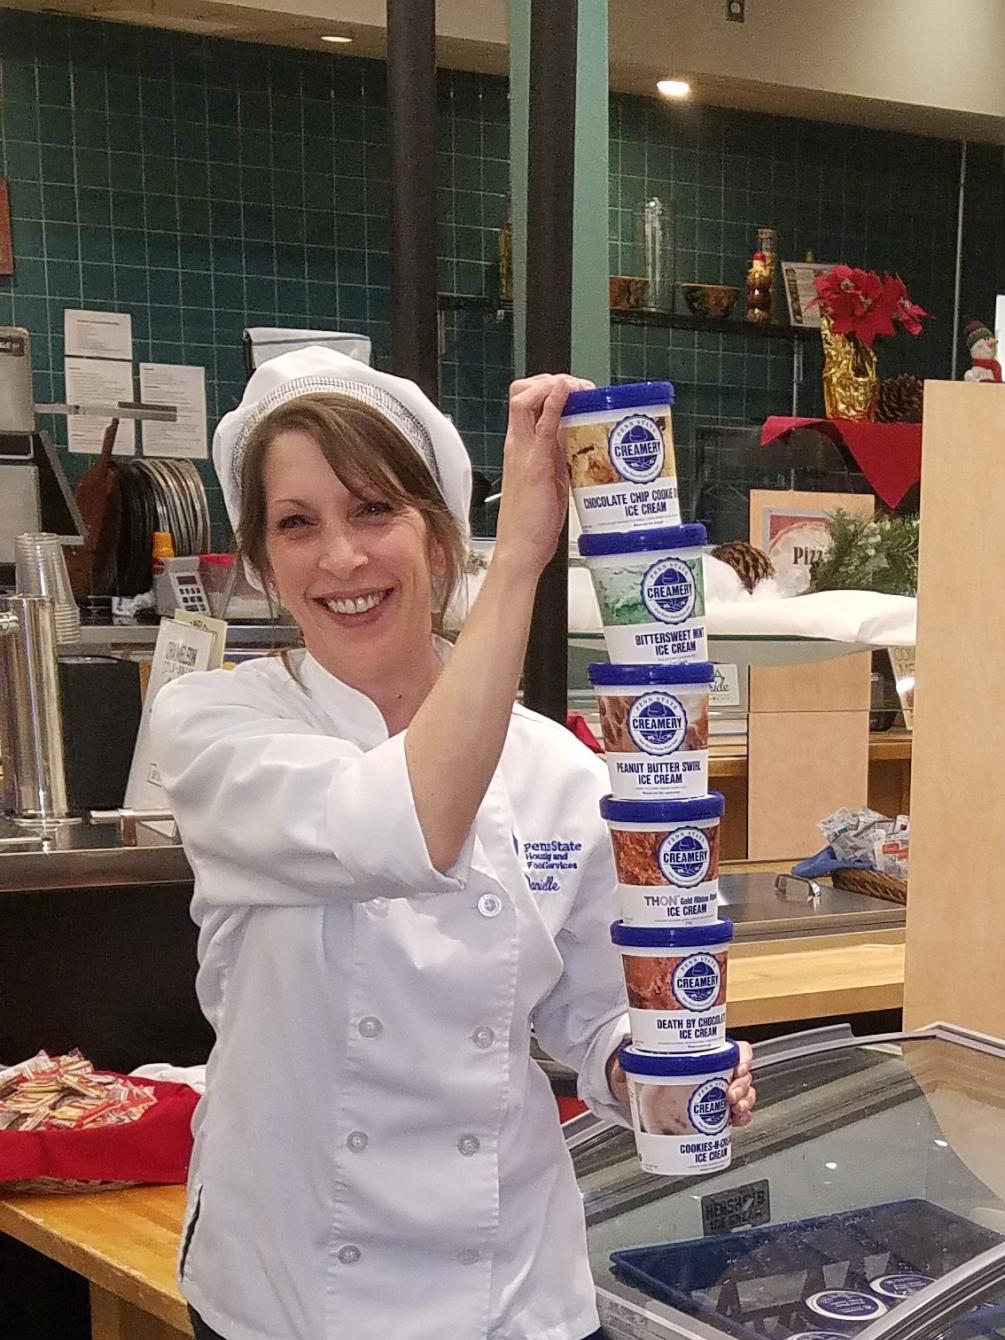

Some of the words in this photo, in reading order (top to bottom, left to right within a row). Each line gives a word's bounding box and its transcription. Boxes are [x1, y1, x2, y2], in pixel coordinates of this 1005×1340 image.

[583, 493, 627, 509] CHOCOLATE
[630, 490, 650, 504] CHIP
[624, 505, 639, 517] ICE
[641, 502, 667, 514] CREAM
[793, 546, 824, 565] Pizz
[635, 629, 691, 646] BITTERSWEET
[655, 645, 669, 656] ICE
[671, 641, 697, 654] CREAM
[632, 717, 682, 730] CREAMERY
[617, 762, 645, 774] PEANUT
[647, 761, 680, 774] BUTTER
[638, 774, 652, 785] ICE
[654, 773, 683, 785] CREAM
[663, 850, 708, 864] CREAMERY
[667, 906, 681, 917] ICE
[682, 904, 707, 916] CREAM
[676, 975, 719, 989] CREAMERY
[657, 1019, 683, 1030] DEATH
[686, 1018, 696, 1028] BY
[679, 1029, 692, 1039] ICE
[694, 1026, 717, 1039] CREAM
[695, 1153, 707, 1163] ICE
[709, 1148, 728, 1161] CREAM
